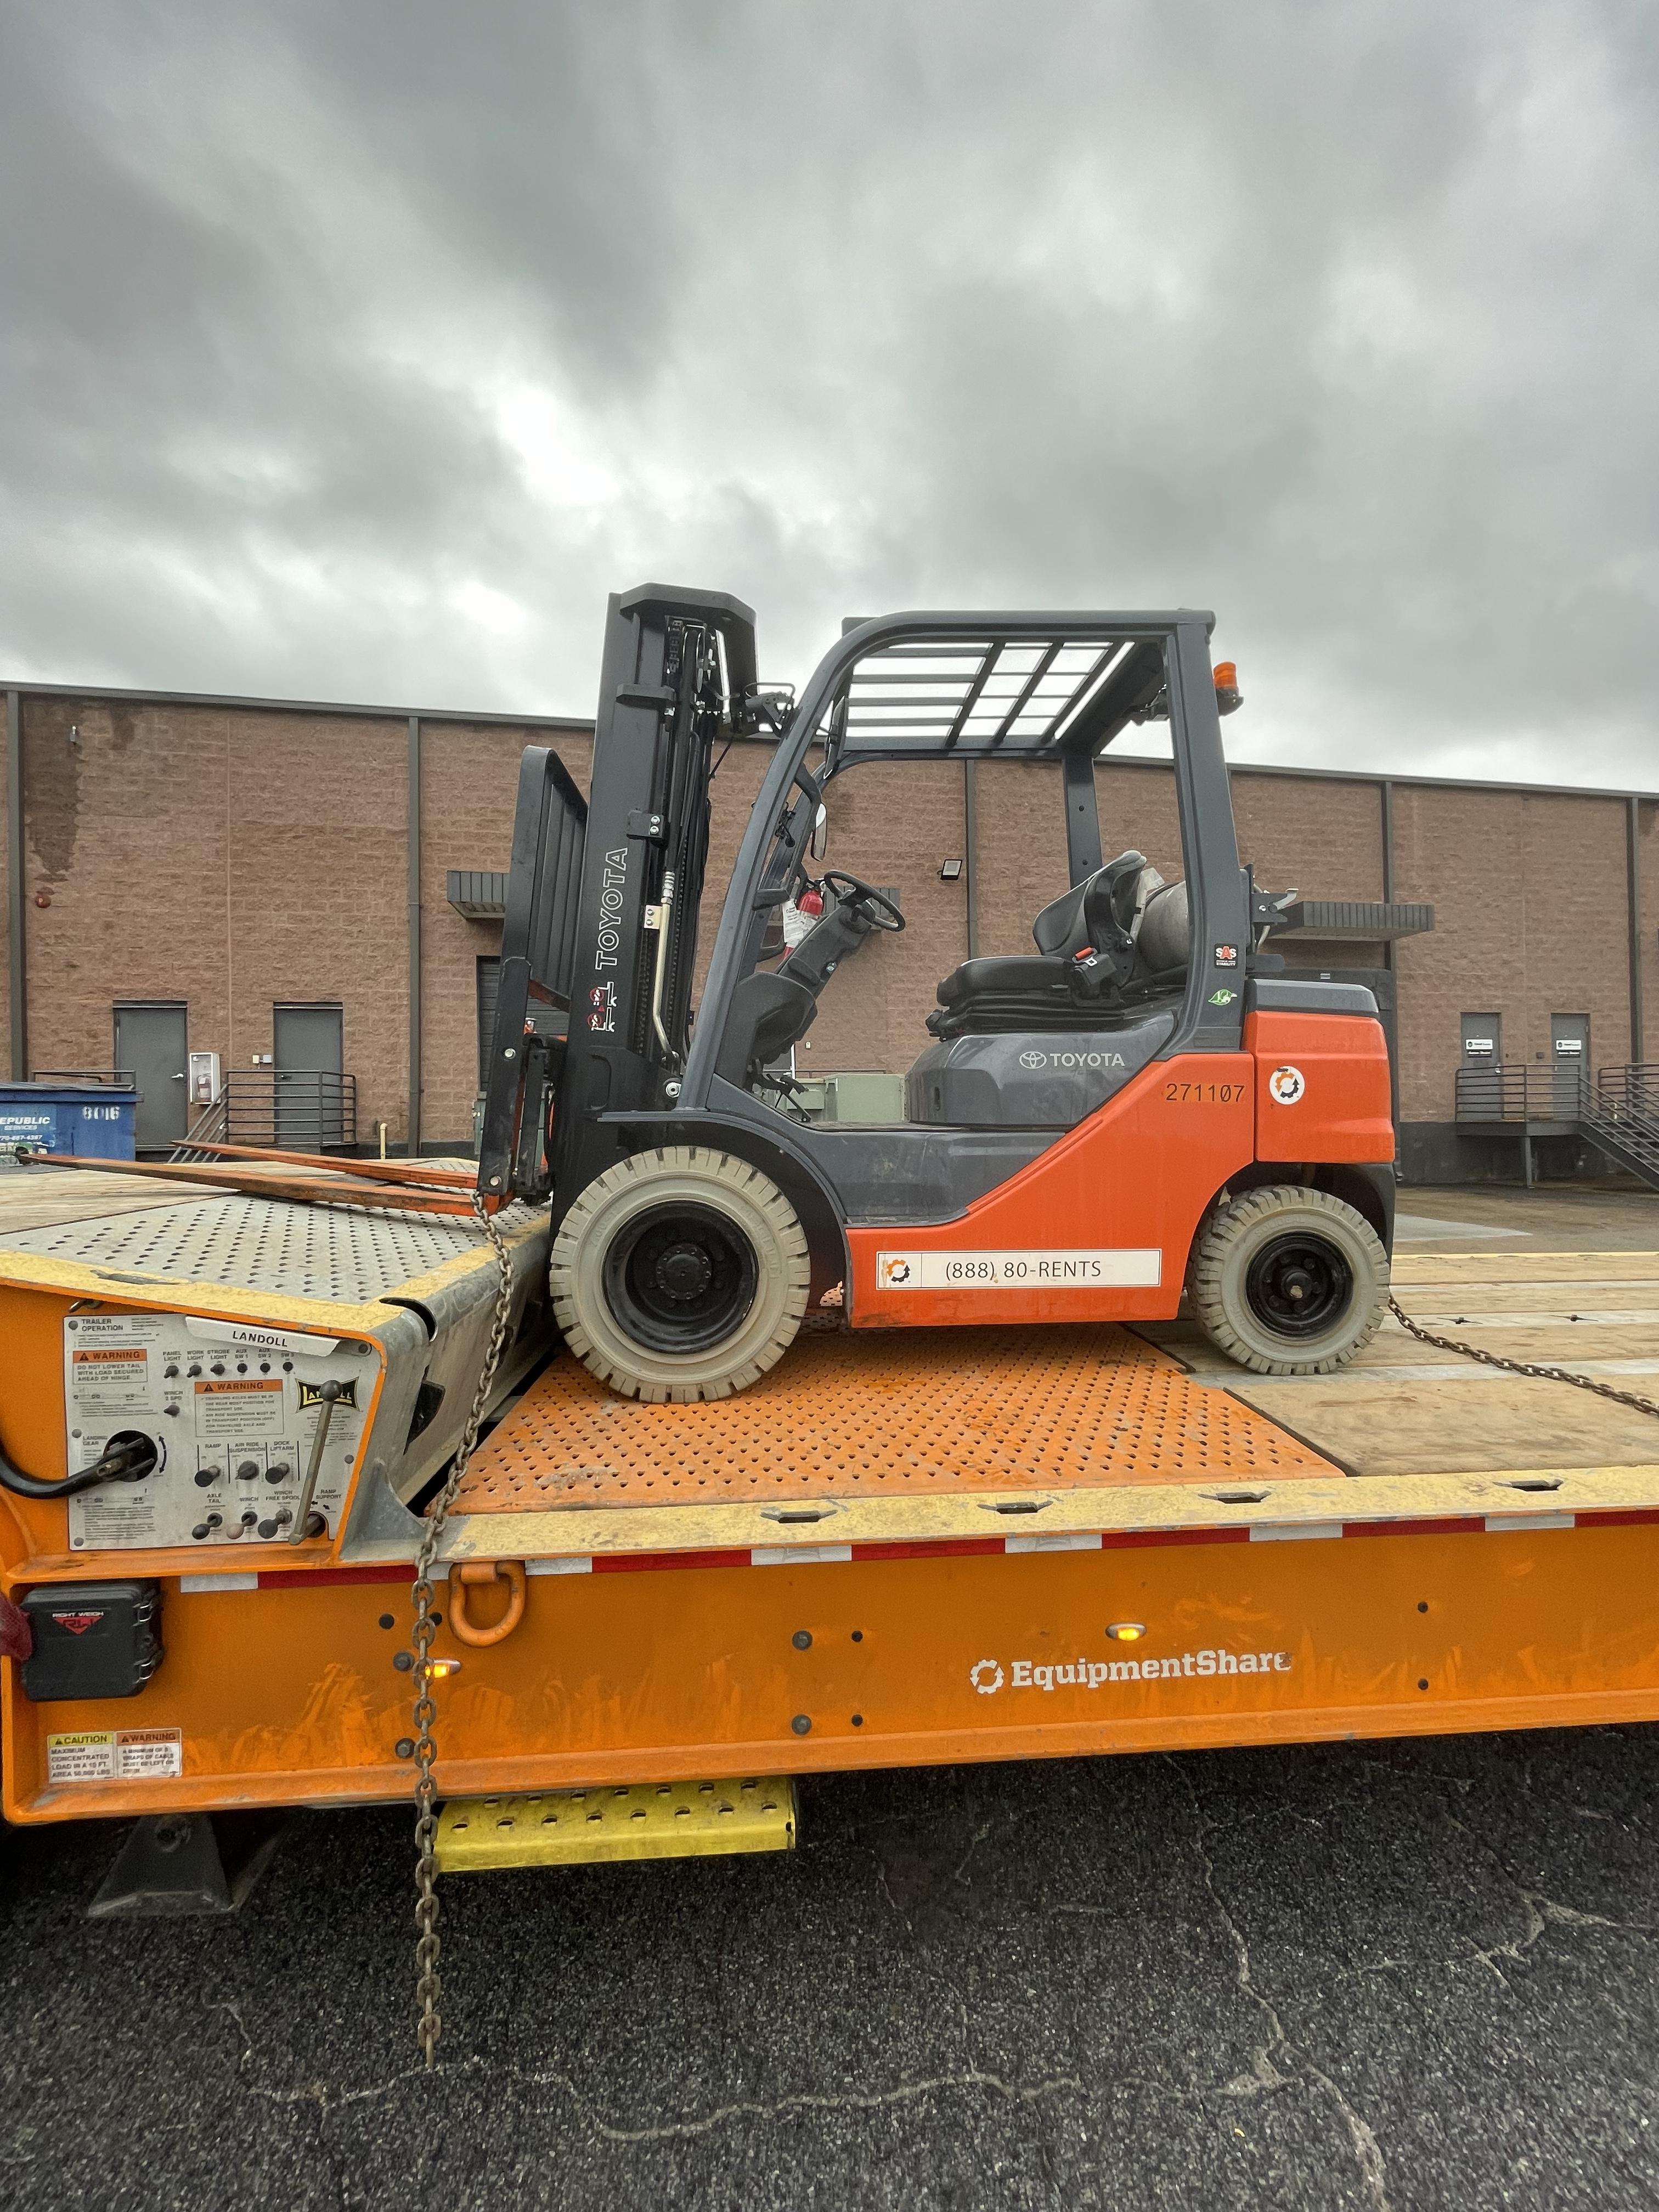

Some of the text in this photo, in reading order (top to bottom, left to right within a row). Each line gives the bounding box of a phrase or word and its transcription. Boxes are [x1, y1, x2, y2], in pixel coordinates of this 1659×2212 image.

[595, 848, 628, 970] TOYOTA
[1216, 946, 1237, 960] SAS
[1050, 1053, 1125, 1067] TOYOTA
[1166, 1084, 1245, 1103] 271107
[946, 1261, 1102, 1281] (888) 80-RENTS
[232, 1330, 288, 1347] LANDOLL
[93, 1351, 140, 1359] WARNING
[1011, 1649, 1291, 1691] EquipmentShare
[64, 1735, 107, 1744] CAUTION
[131, 1733, 176, 1742] WARNING
